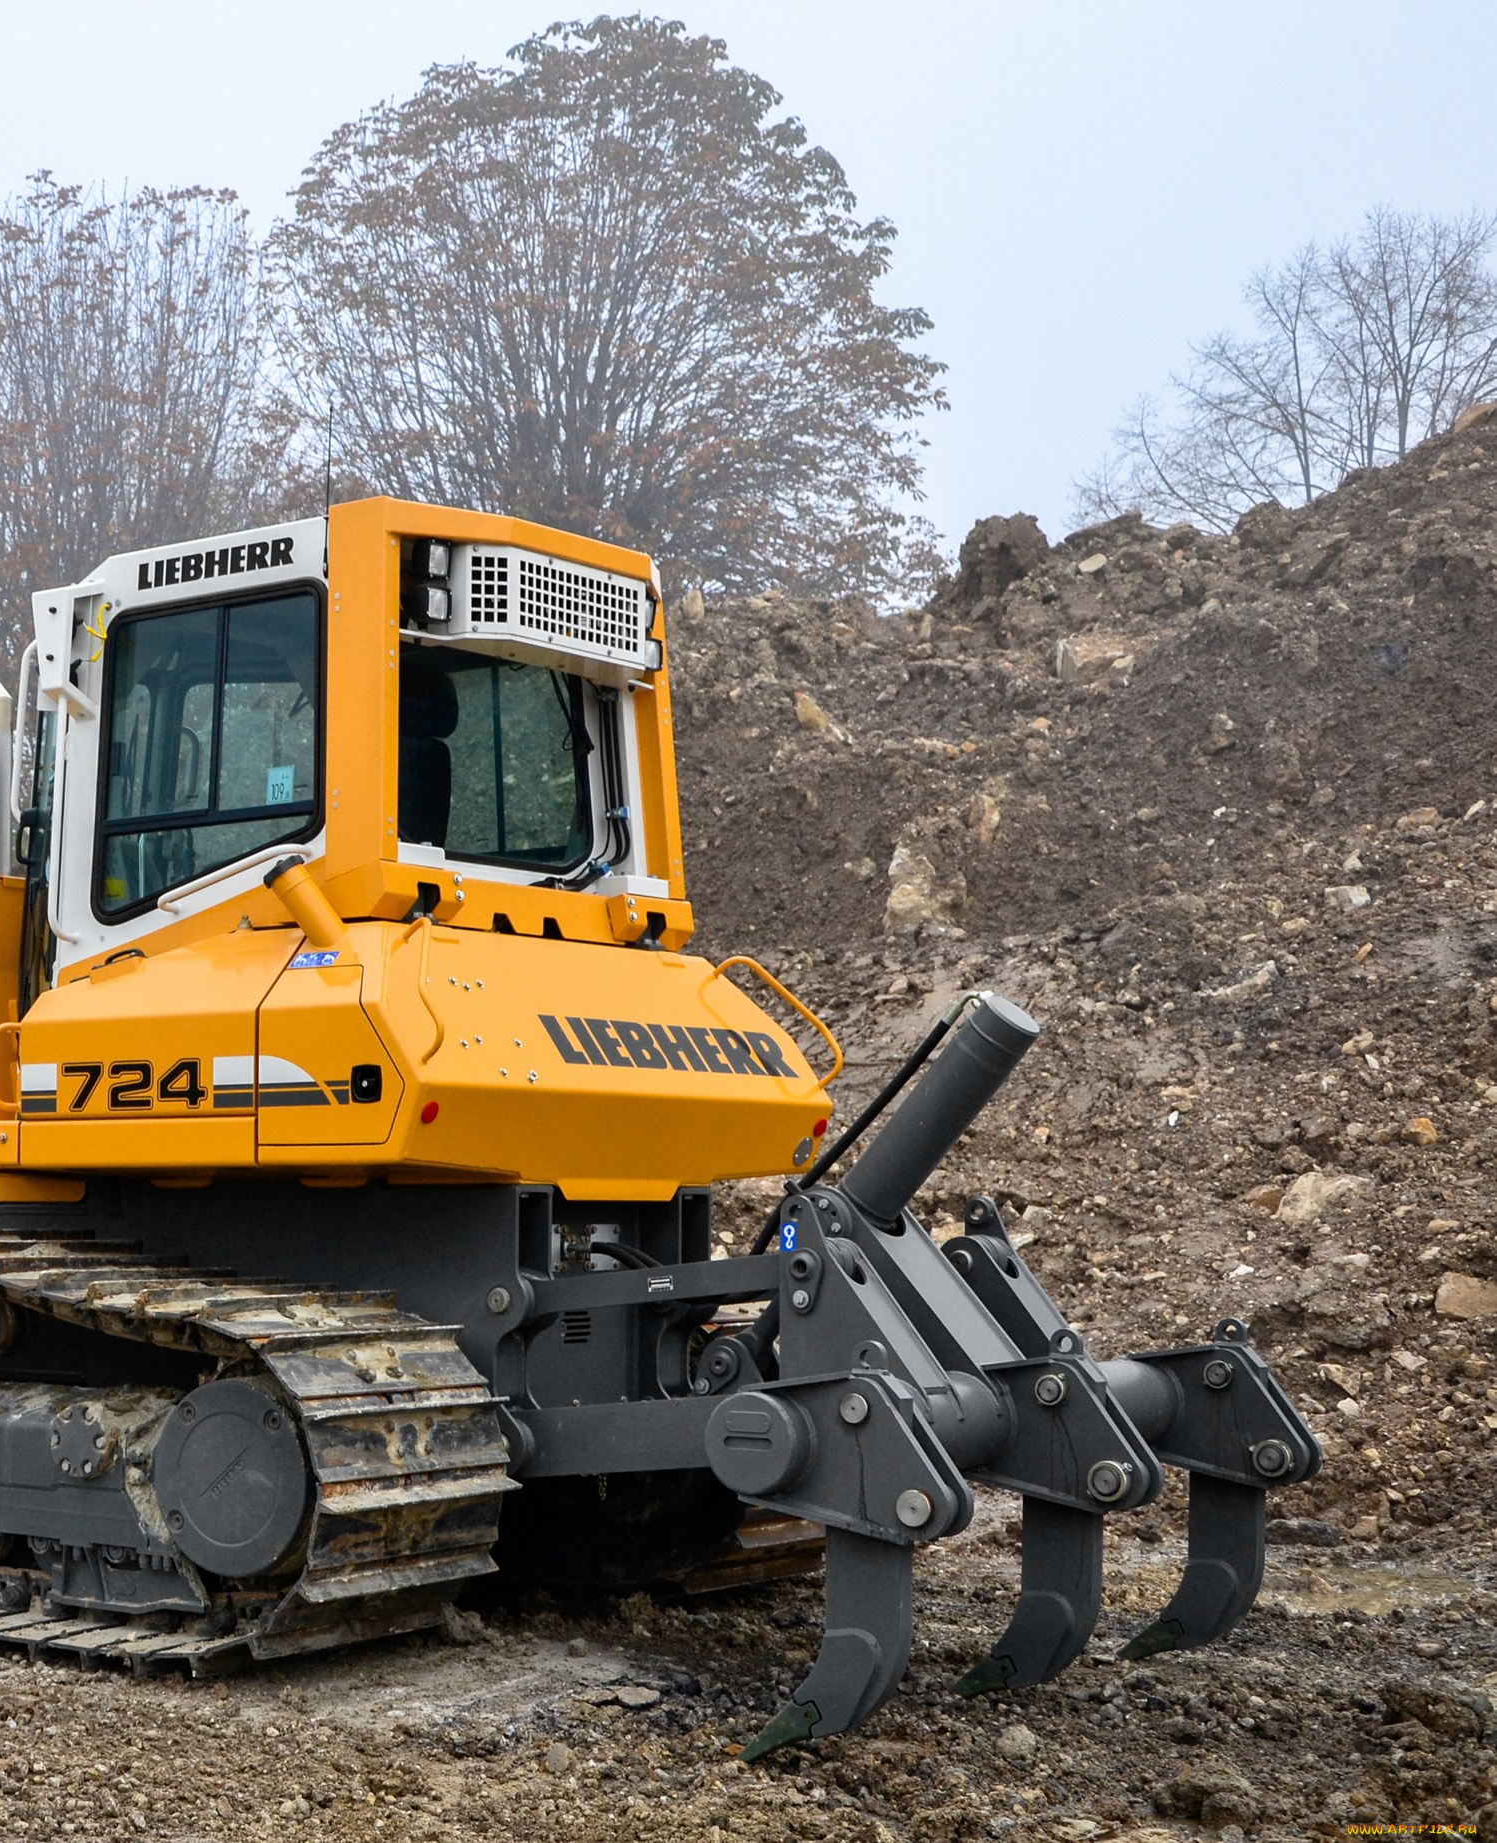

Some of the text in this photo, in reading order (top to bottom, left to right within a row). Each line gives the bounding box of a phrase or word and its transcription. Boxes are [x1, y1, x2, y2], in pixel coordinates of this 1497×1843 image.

[138, 537, 294, 590] LIEBHERR
[537, 1014, 800, 1078] LIEBHERR
[61, 1058, 208, 1112] 724
